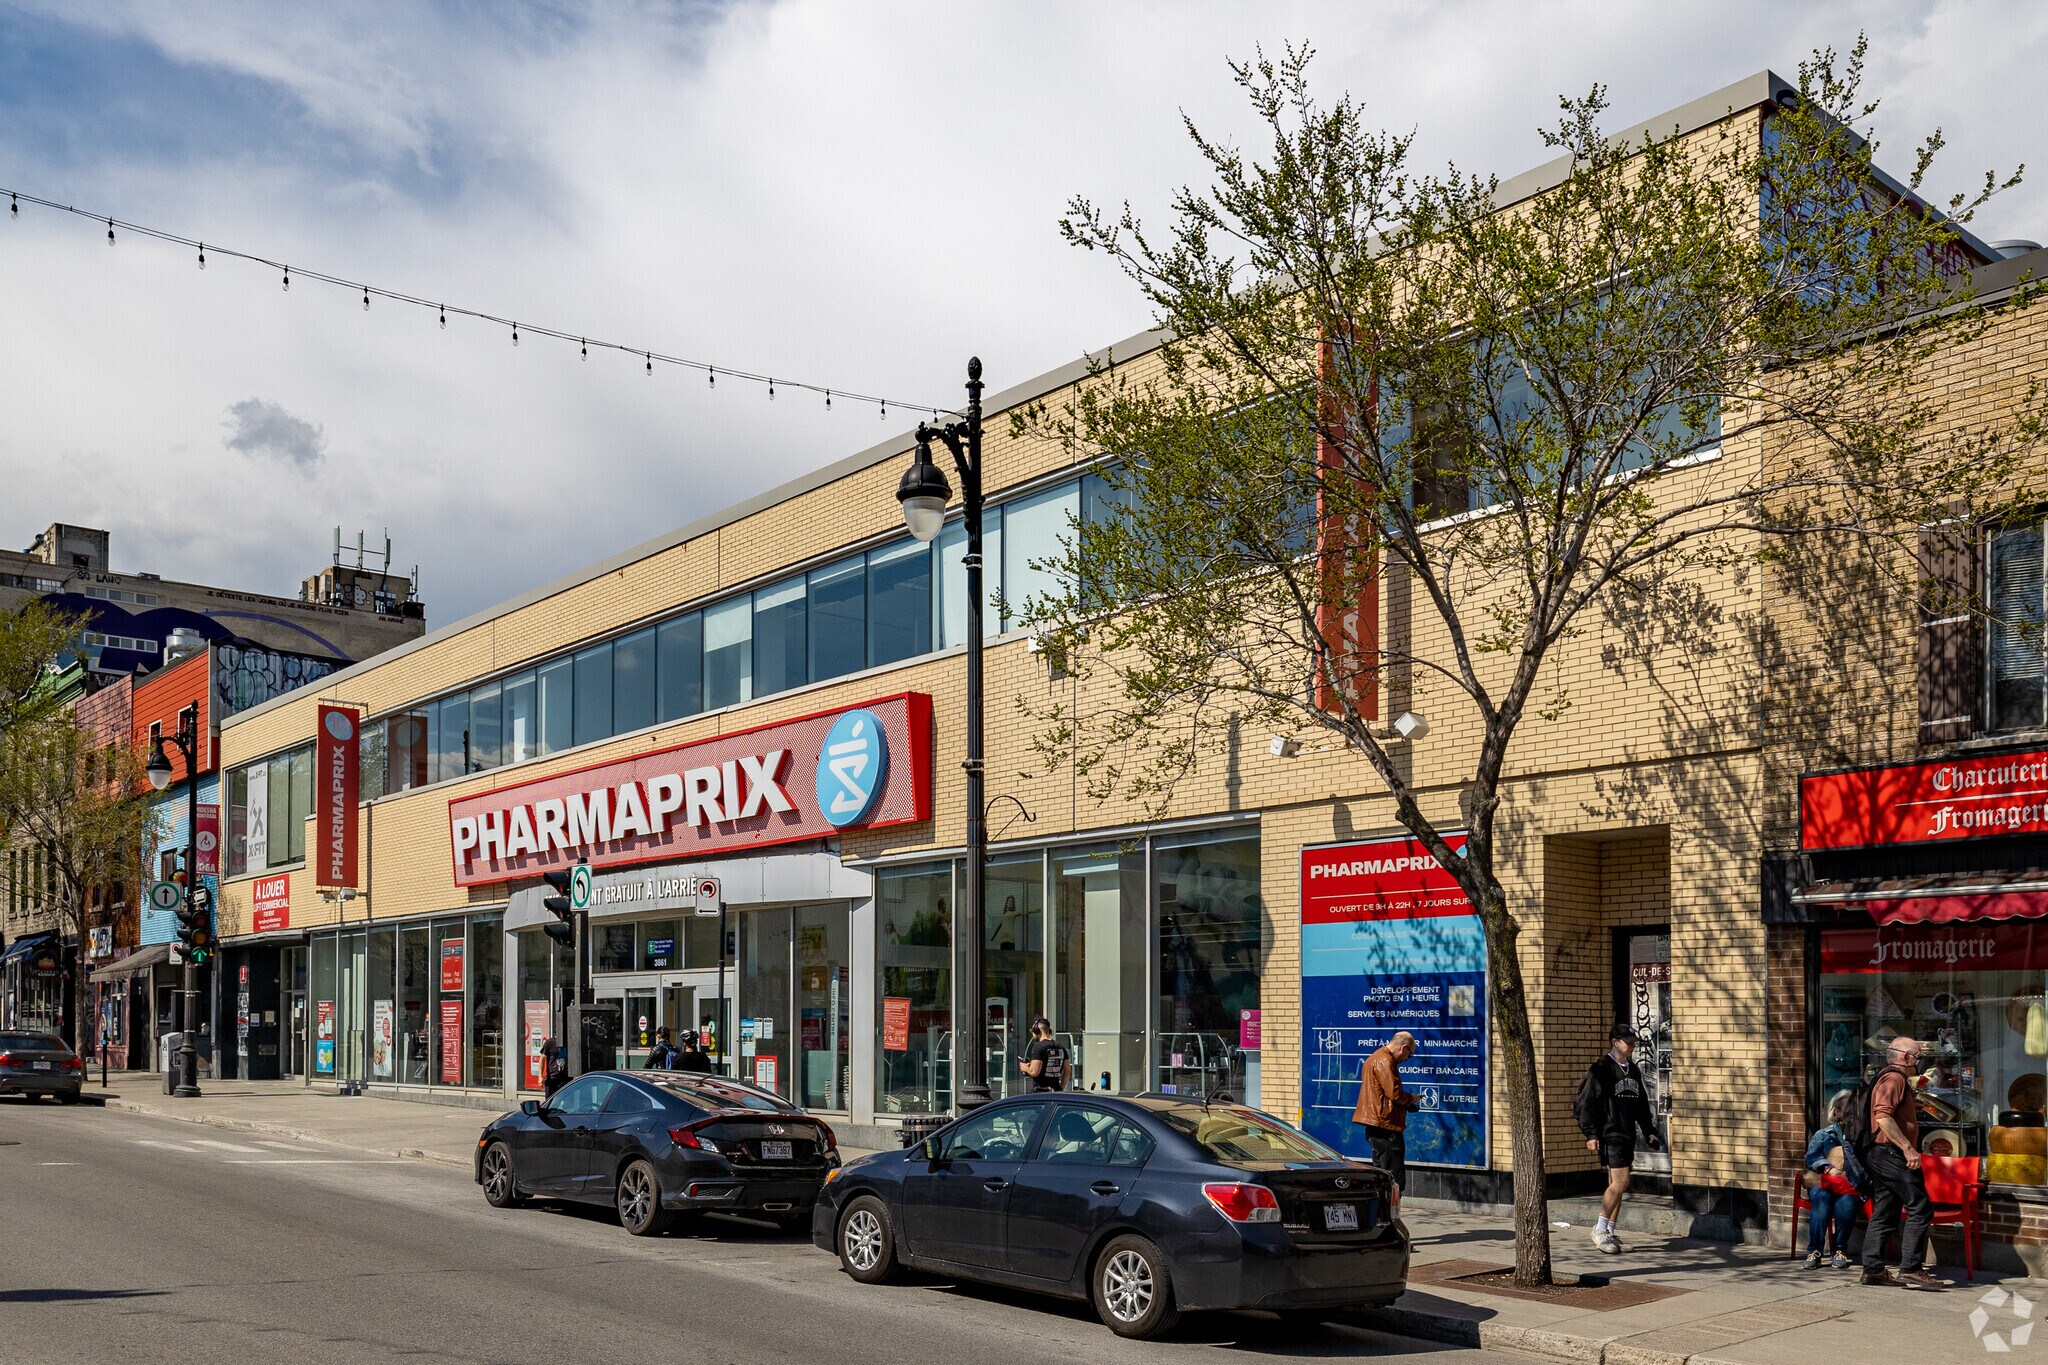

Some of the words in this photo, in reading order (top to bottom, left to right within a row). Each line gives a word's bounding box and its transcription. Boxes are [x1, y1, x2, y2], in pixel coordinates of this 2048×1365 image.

[1932, 757, 2048, 792] Charcuteri
[332, 745, 344, 880] PHARMAPRIX
[452, 749, 796, 865] PHARMAPRIX
[1310, 855, 1444, 879] PHARMAPRIX
[256, 881, 261, 900] À
[262, 879, 285, 899] LOUER
[605, 883, 643, 904] GRATUIT
[647, 878, 655, 900] À
[657, 873, 697, 899] L'ARRIÈ
[262, 898, 289, 910] COMMERCIAL
[1329, 904, 1361, 914] OUVERT
[1363, 903, 1374, 911] DE
[1388, 901, 1394, 910] À
[1395, 901, 1411, 910] 22H
[1424, 899, 1451, 908] JOURS
[1453, 897, 1471, 906] SUR
[1371, 986, 1440, 994] DÉVELOPPEMENT
[1363, 995, 1391, 1003] PHOTO
[1411, 994, 1440, 1002] HEURE
[1347, 1010, 1386, 1018] SERVICES
[1387, 1009, 1440, 1018] NUMÉRIQUES
[1424, 1038, 1478, 1048] MINI-MARCHÉ
[1398, 1066, 1434, 1074] GUICHET
[1436, 1067, 1479, 1075] BANCAIRE
[1443, 1095, 1479, 1103] LOTERIE
